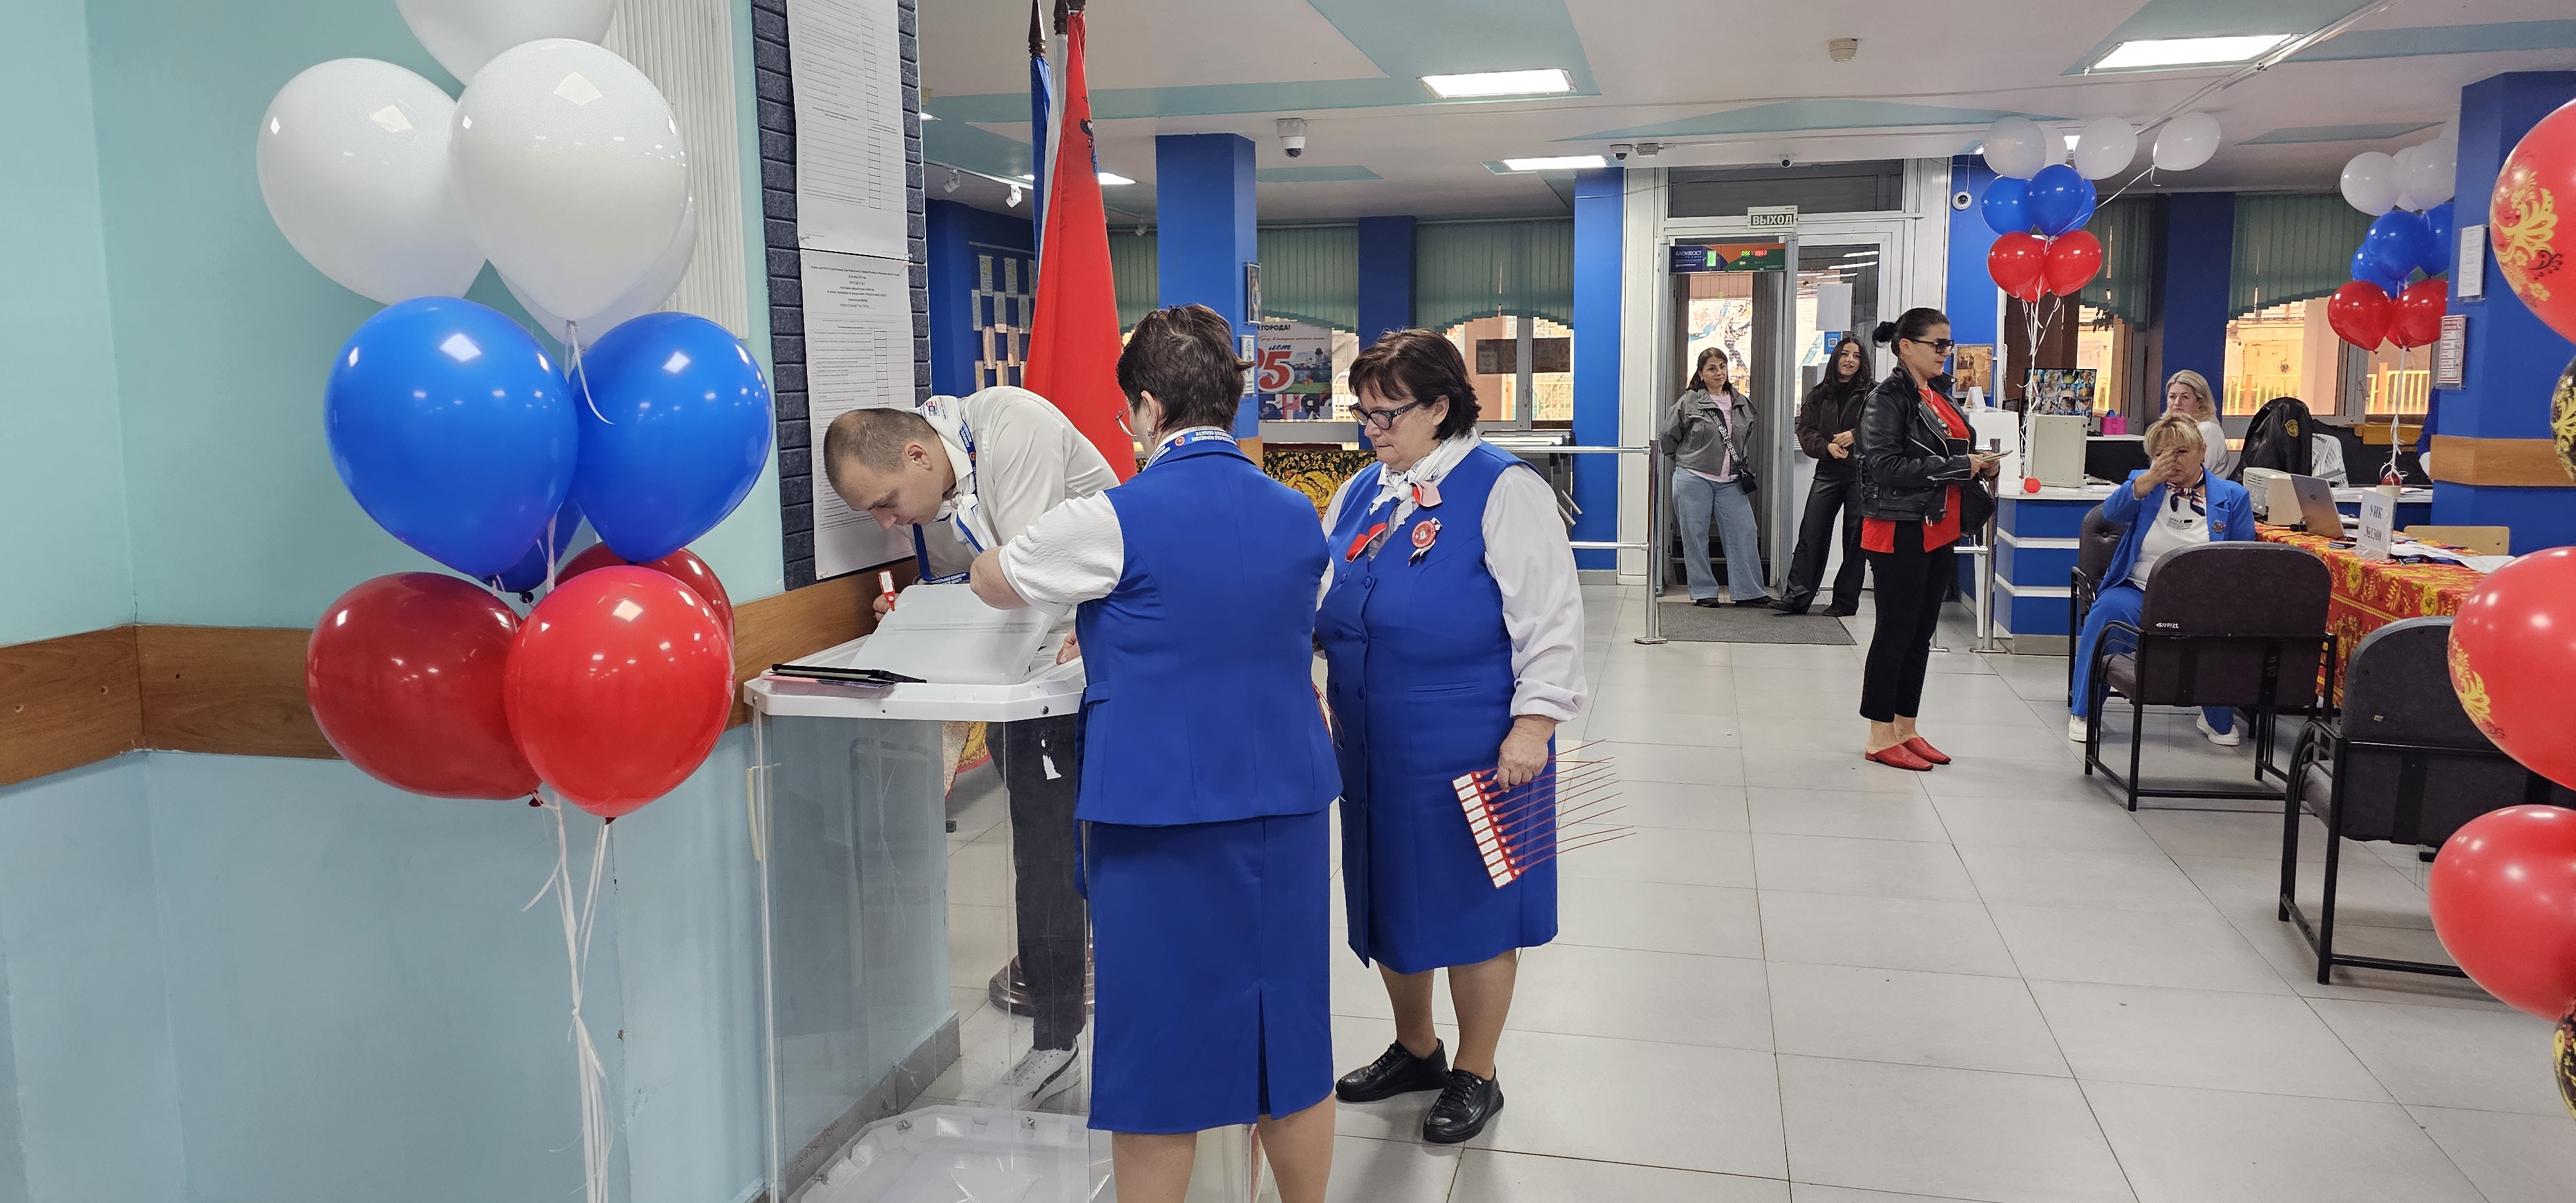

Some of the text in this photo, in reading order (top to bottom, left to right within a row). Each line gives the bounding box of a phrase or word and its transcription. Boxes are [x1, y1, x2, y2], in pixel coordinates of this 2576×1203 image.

[1753, 214, 1793, 225] ВЫХОД
[2370, 505, 2383, 519] УИК
[2364, 526, 2382, 541] №1308
